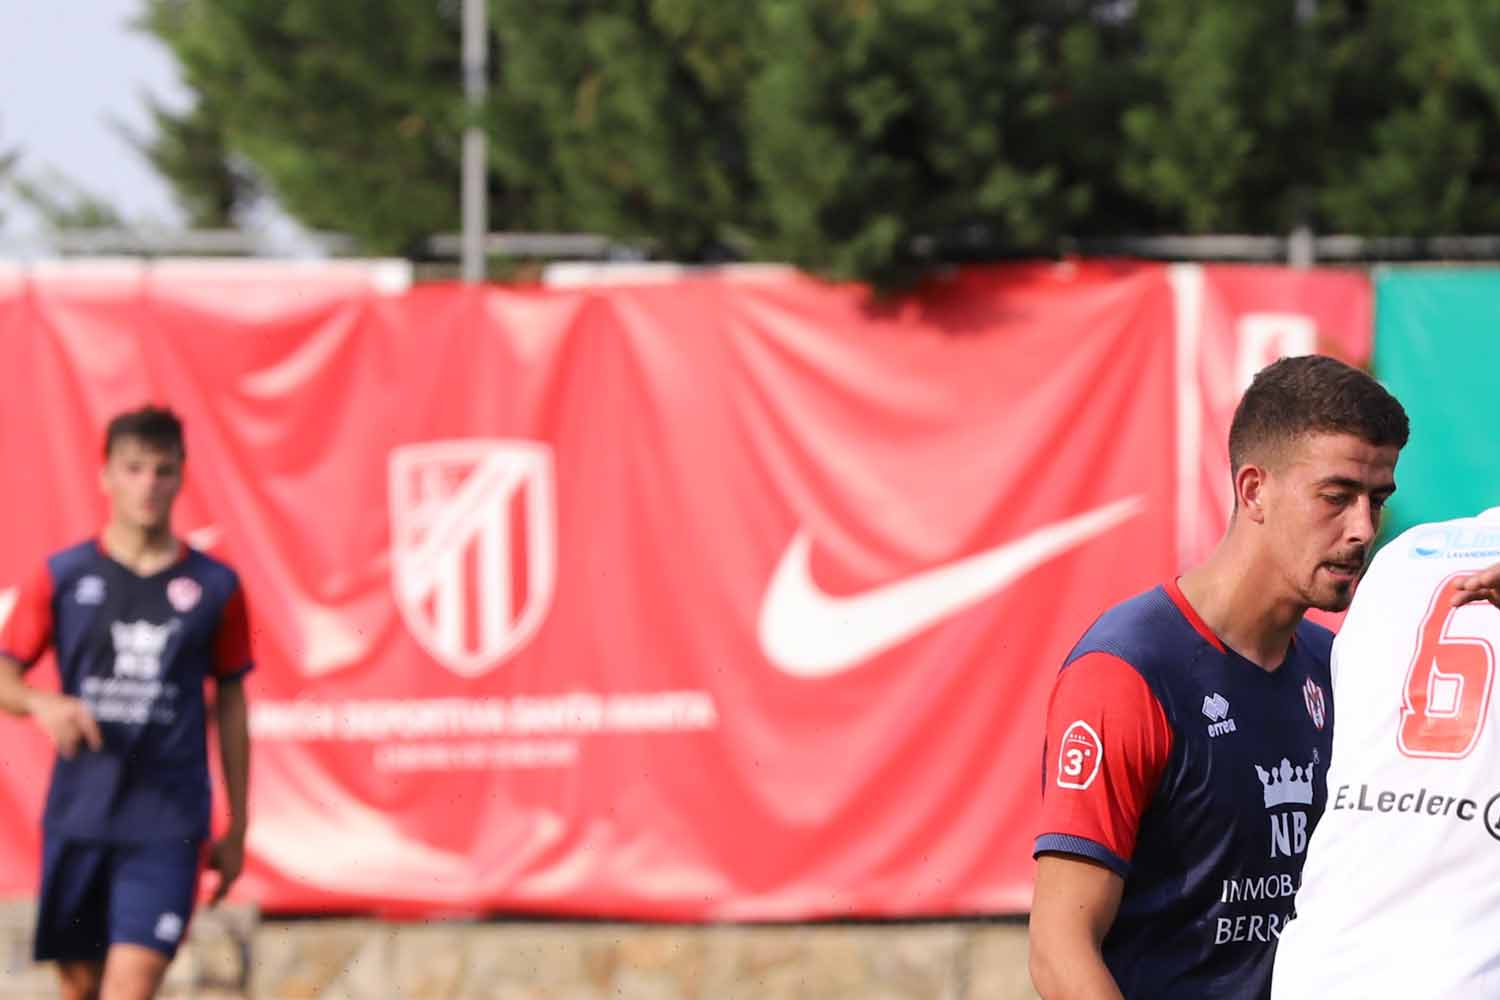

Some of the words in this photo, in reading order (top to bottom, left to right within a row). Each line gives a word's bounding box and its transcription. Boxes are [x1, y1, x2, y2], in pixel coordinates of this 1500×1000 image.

[1396, 569, 1496, 761] 6
[1333, 784, 1478, 821] E.Leclerc
[1270, 810, 1308, 859] NB
